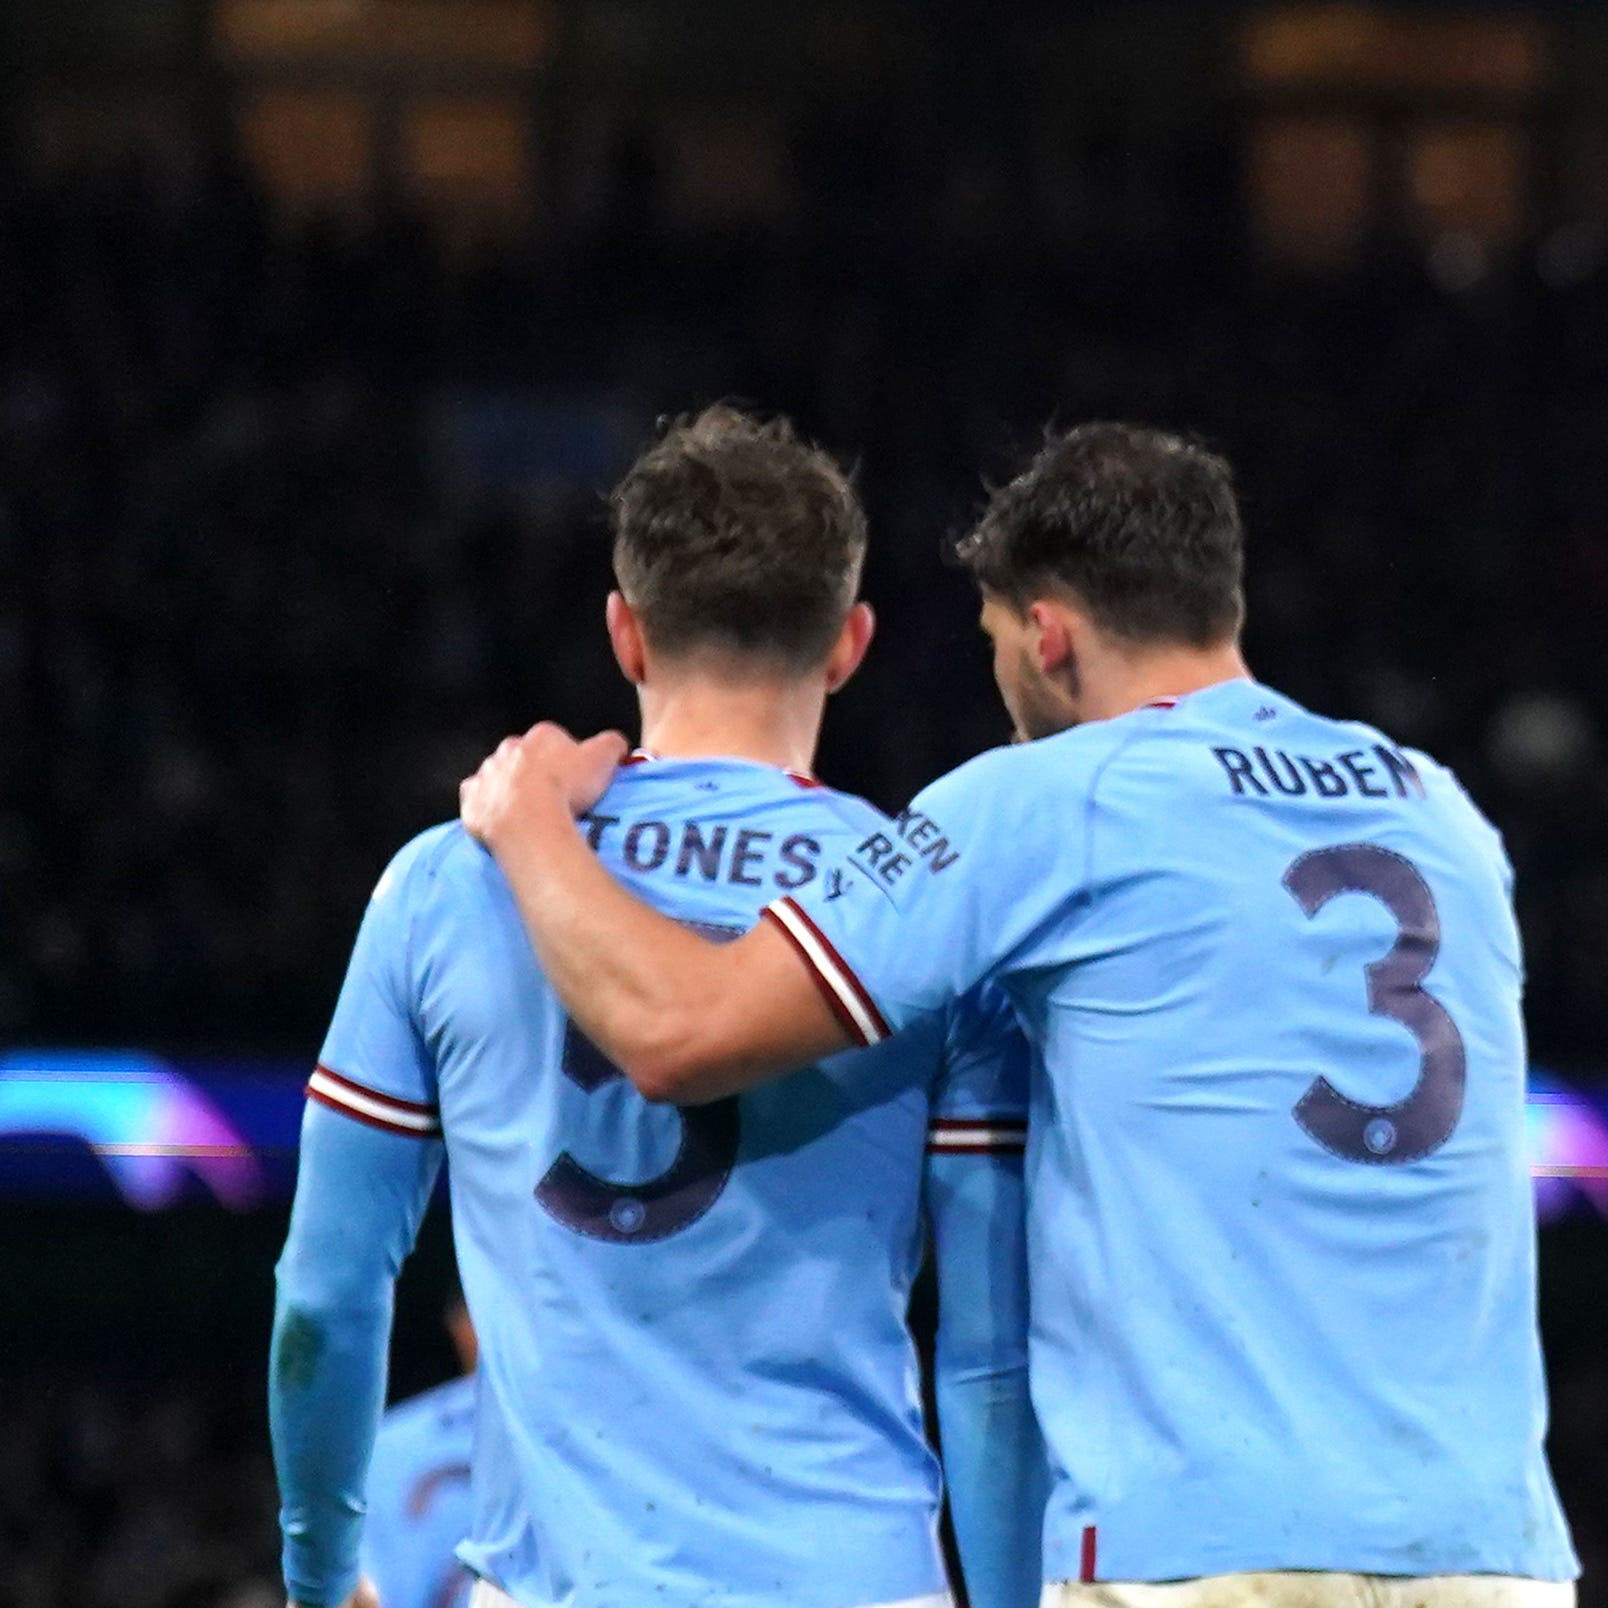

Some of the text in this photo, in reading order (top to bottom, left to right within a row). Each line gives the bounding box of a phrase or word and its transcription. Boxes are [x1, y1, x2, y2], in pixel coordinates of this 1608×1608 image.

[1209, 744, 1426, 800] RUBEN
[576, 811, 822, 890] TONES
[1281, 842, 1467, 1166] 3
